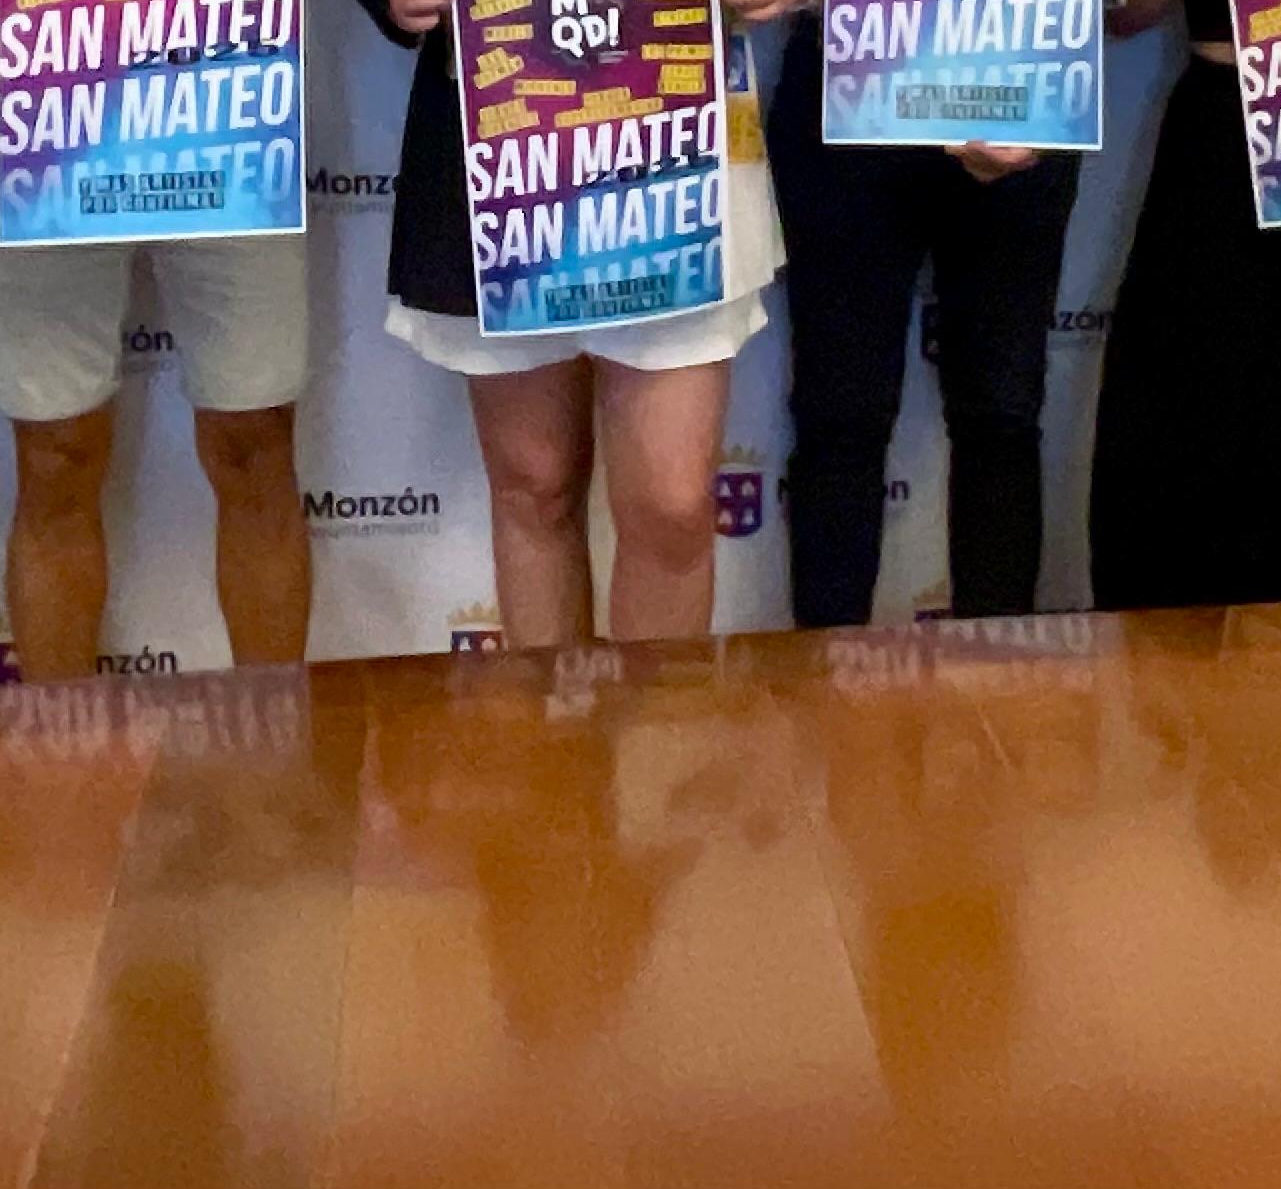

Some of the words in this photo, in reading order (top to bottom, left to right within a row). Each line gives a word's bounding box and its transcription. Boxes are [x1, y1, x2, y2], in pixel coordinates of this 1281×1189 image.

[0, 5, 105, 78] SAN
[551, 8, 618, 58] QD!
[828, 1, 922, 62] SAN
[1, 82, 106, 156] SAN
[120, 62, 294, 143] MATEO
[468, 132, 559, 201] SAN
[573, 101, 718, 186] MATEO
[474, 202, 564, 270] SAN
[578, 172, 720, 255] MATEO
[303, 486, 441, 519] Monzón
[96, 644, 177, 675] nzón
